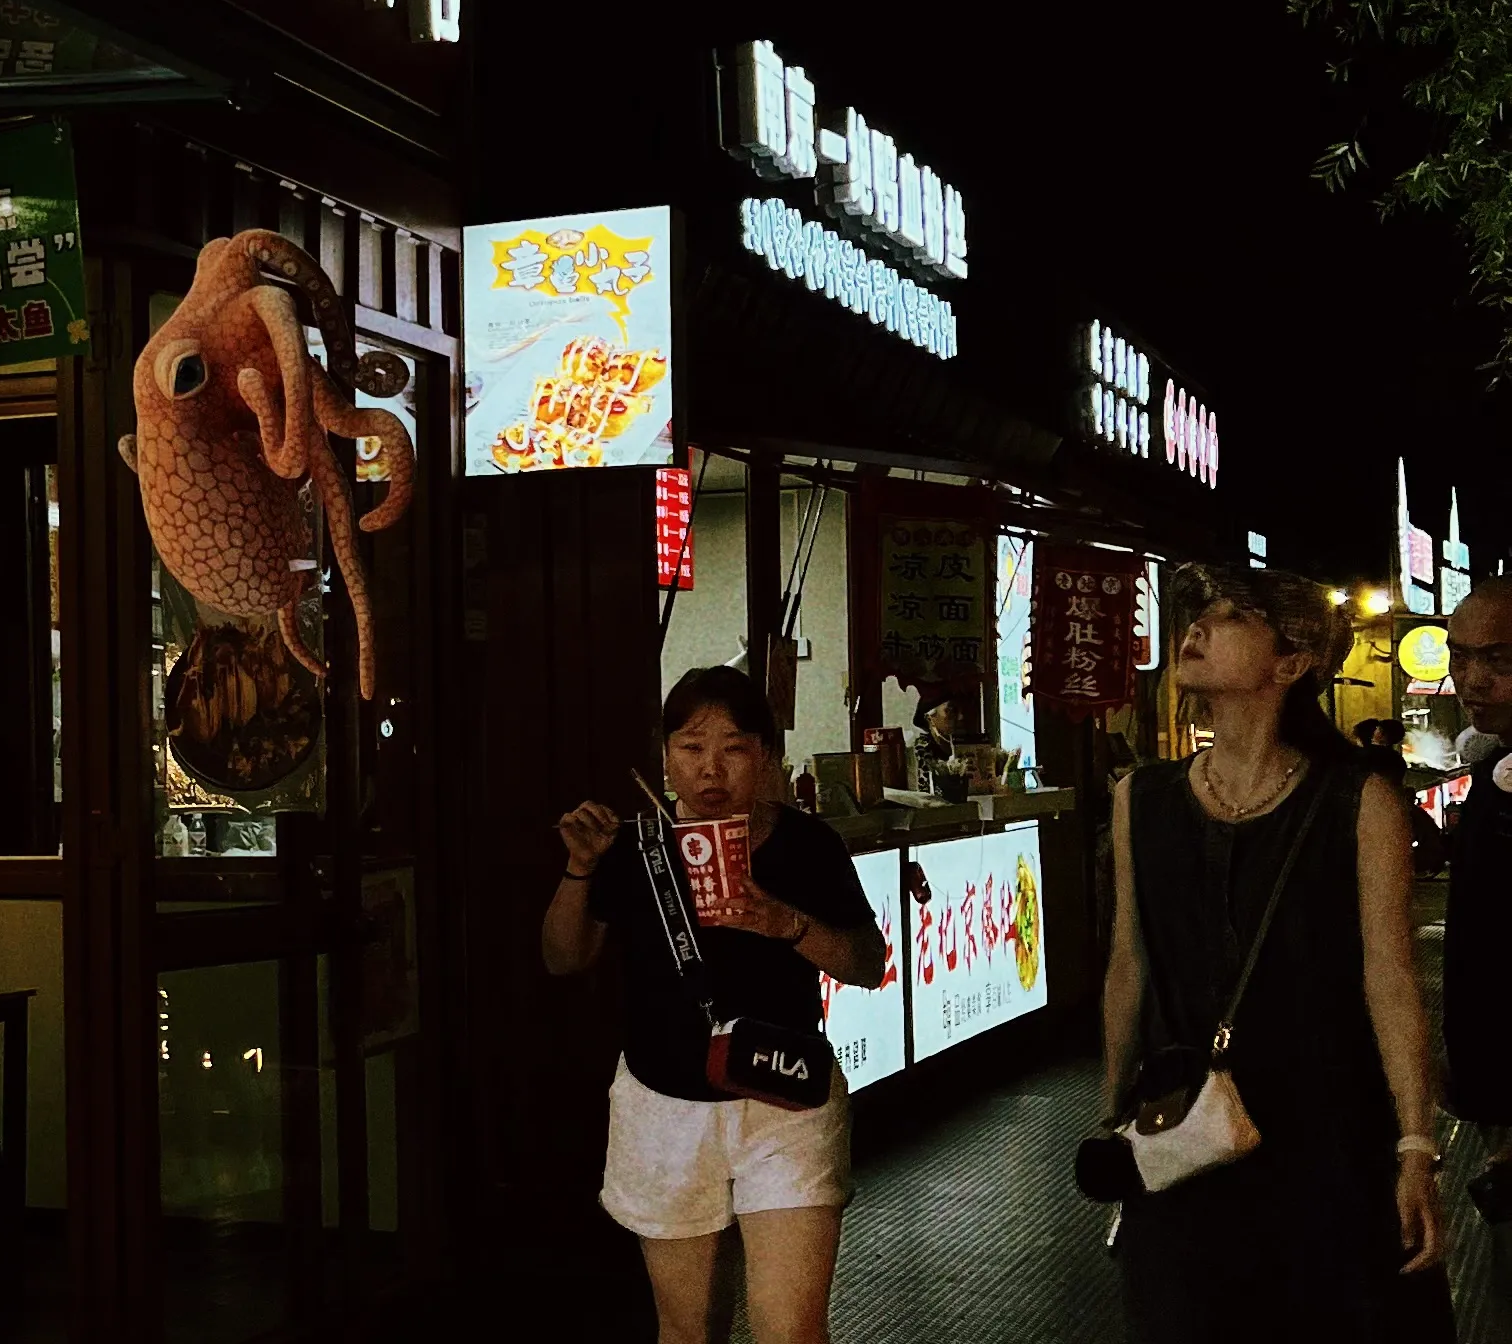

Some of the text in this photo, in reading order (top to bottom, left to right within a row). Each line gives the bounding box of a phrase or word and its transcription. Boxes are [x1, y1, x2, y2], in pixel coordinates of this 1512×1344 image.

[1059, 595, 1108, 697] 爆肚粉丝
[675, 931, 695, 962] FILA
[752, 1049, 809, 1081] FILA
